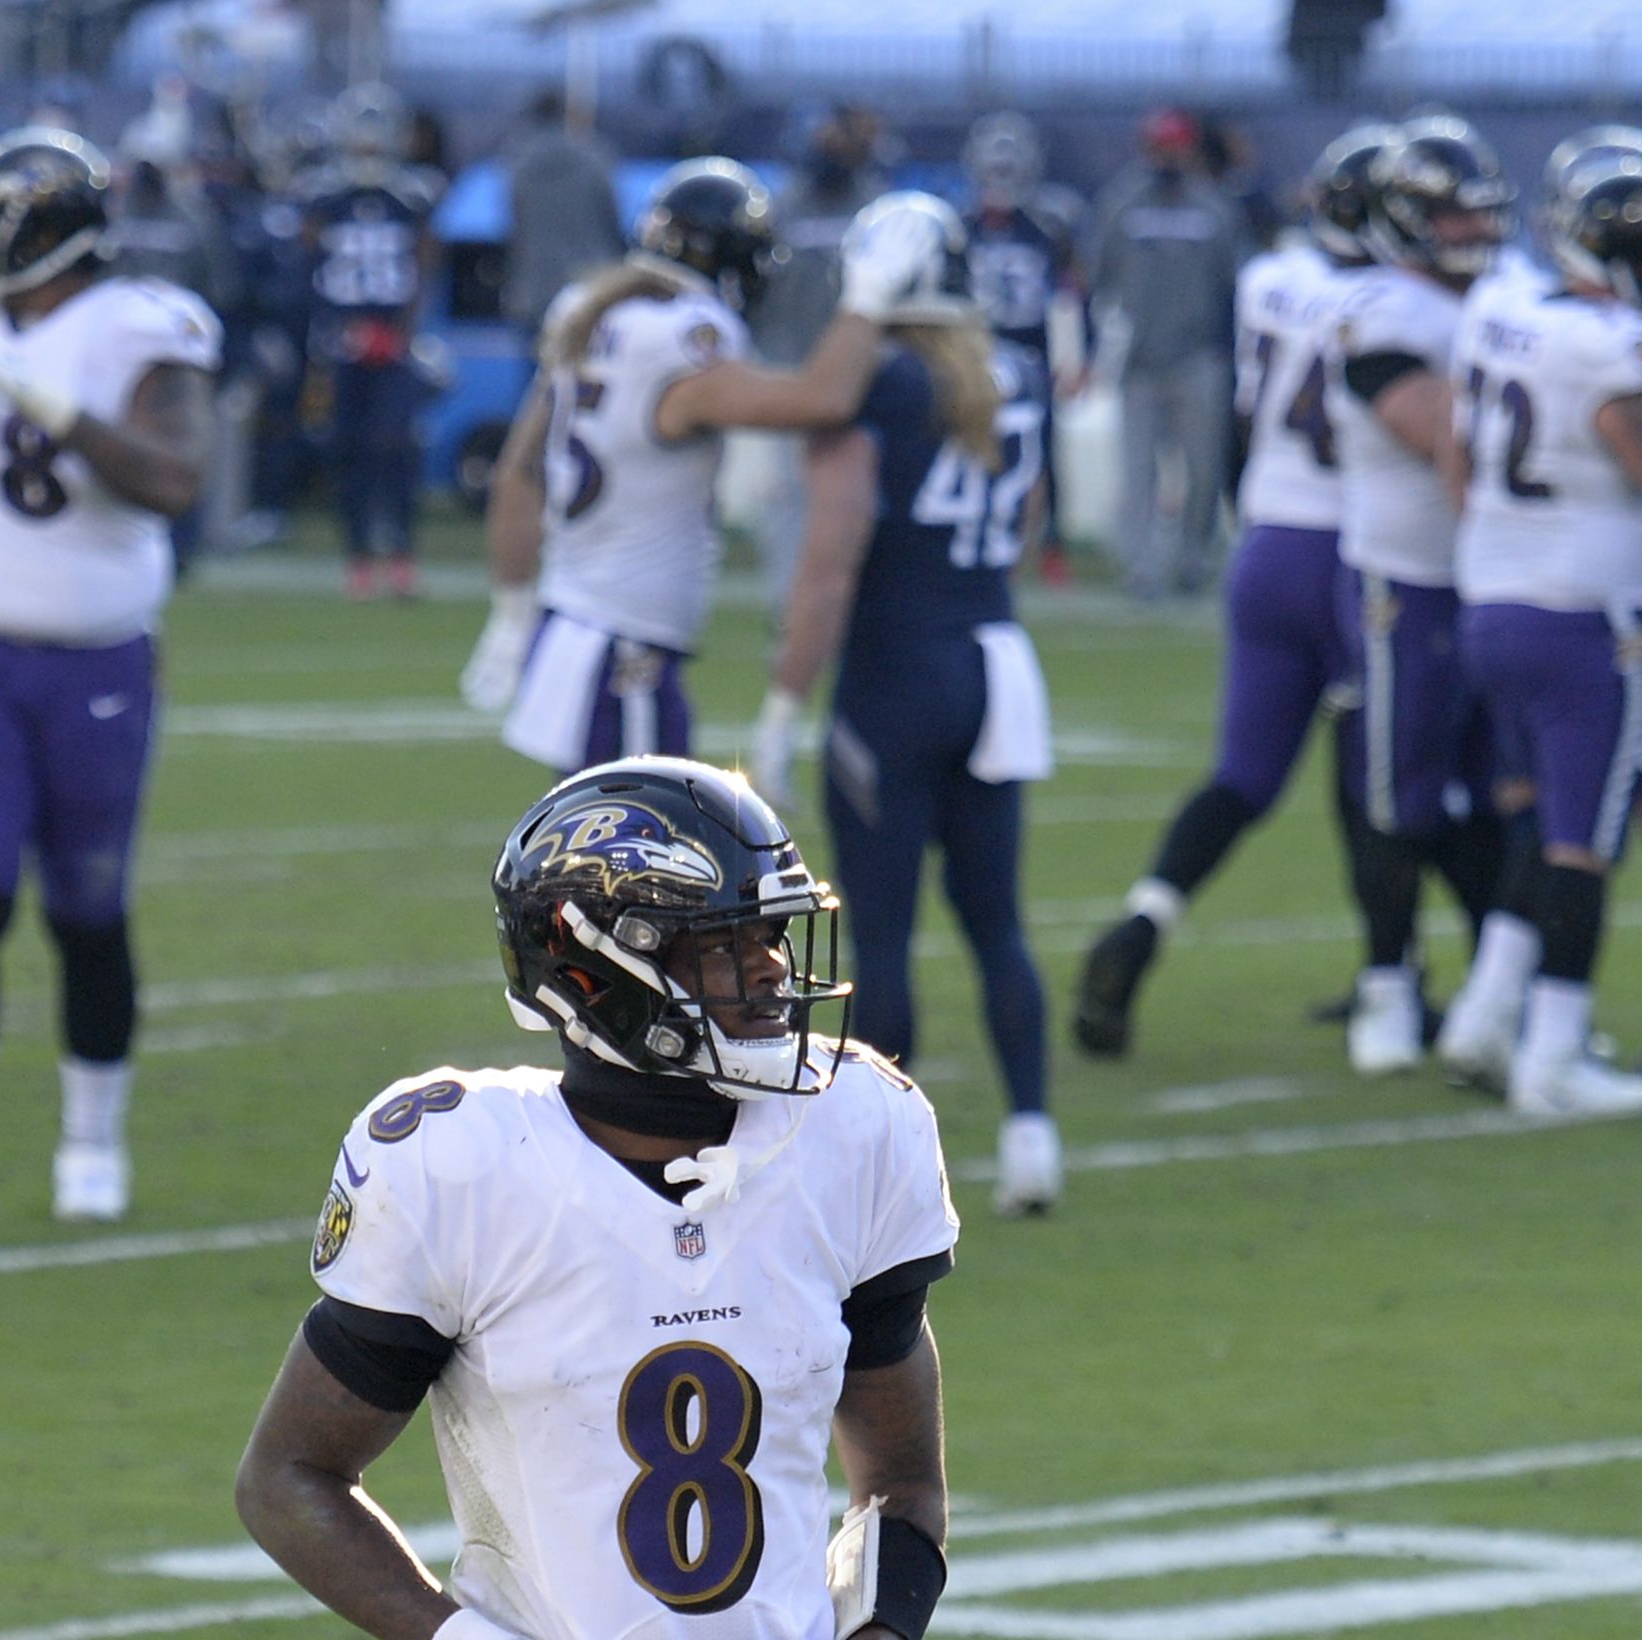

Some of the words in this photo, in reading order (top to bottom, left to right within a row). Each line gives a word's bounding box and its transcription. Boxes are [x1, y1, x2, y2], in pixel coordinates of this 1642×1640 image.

[563, 807, 628, 851] B
[367, 1079, 467, 1145] 8
[678, 1236, 704, 1256] NFL
[650, 1306, 743, 1328] RAVENS
[615, 1338, 765, 1615] 8
